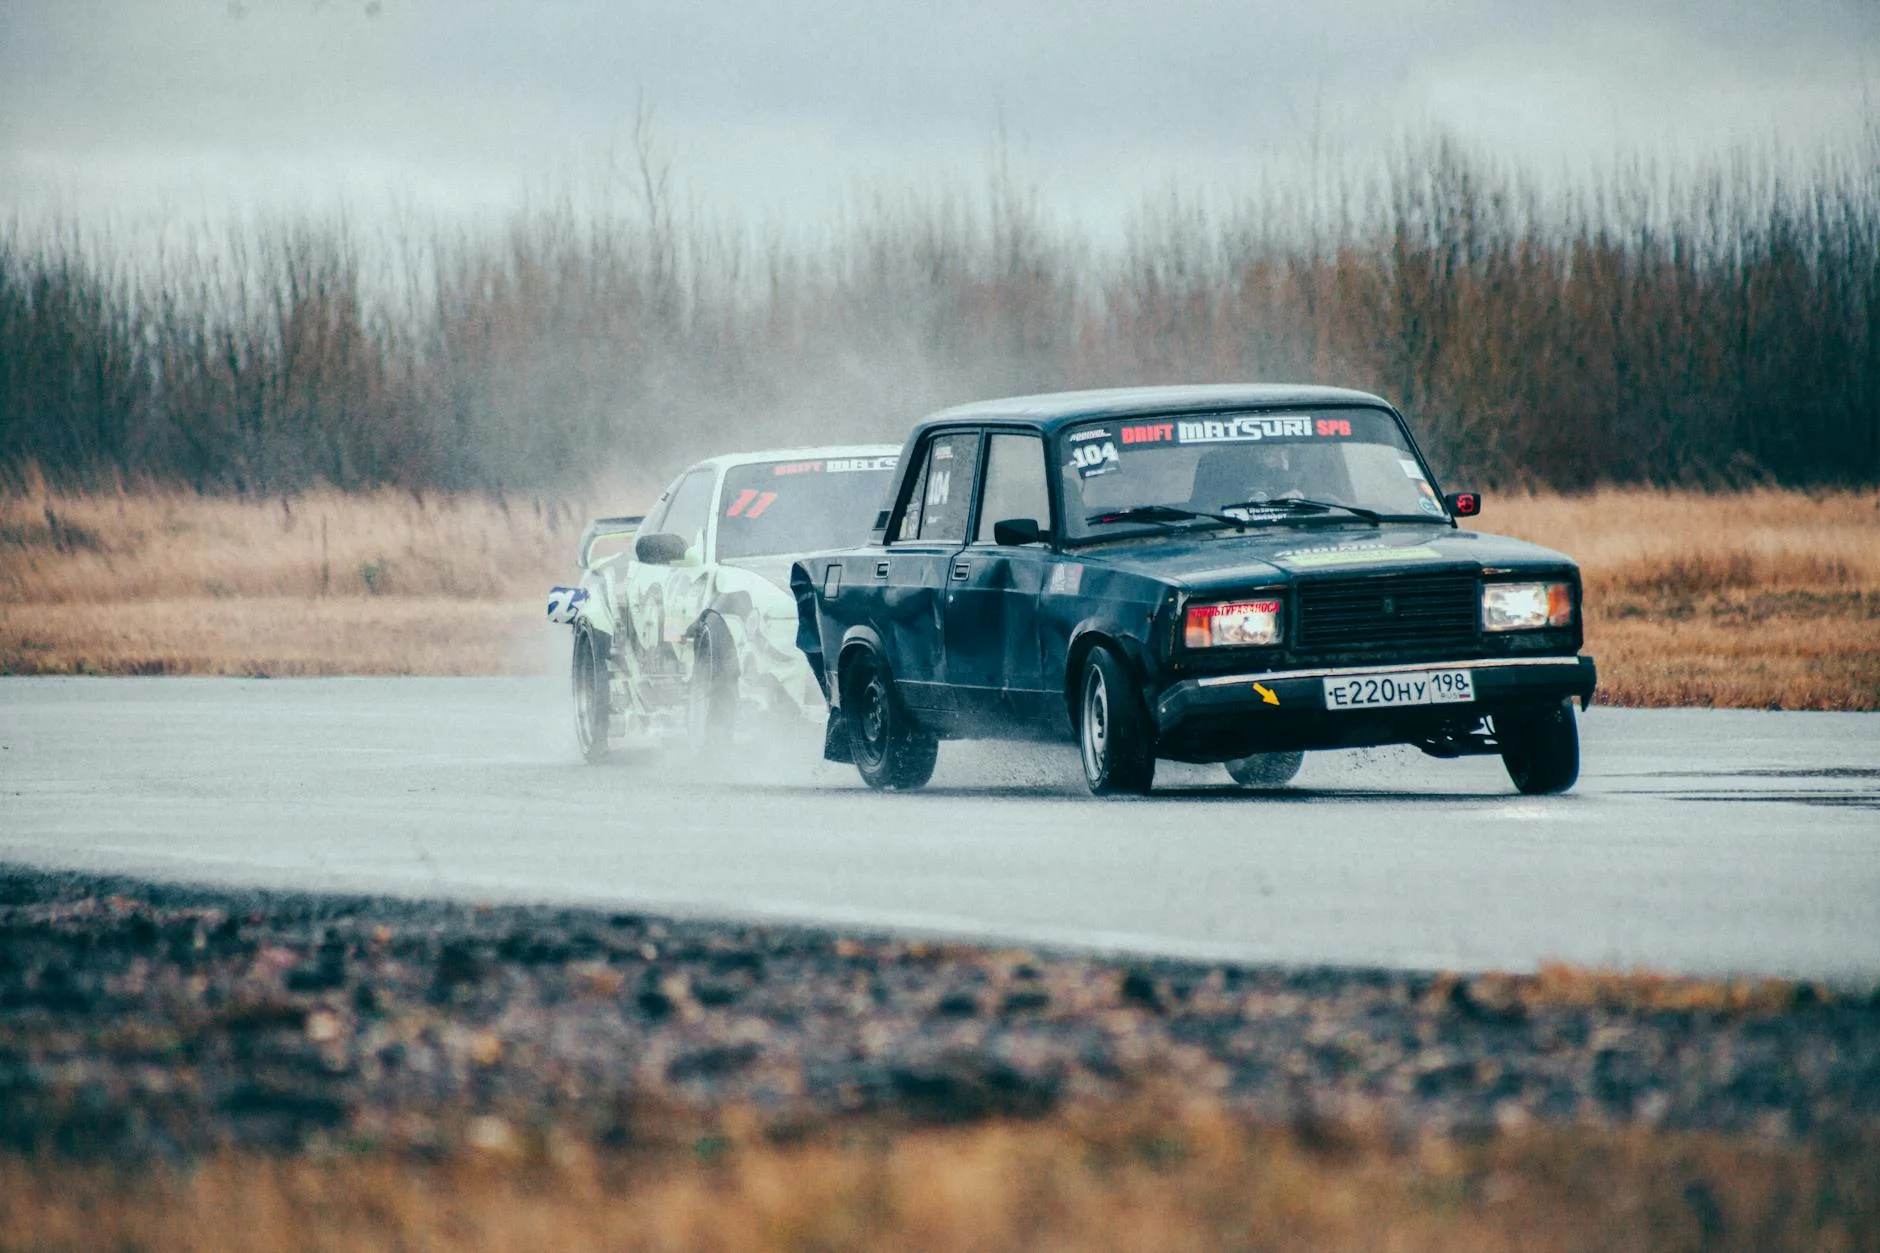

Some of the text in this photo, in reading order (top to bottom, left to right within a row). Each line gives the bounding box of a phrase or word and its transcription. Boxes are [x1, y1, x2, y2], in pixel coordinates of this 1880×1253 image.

[1121, 416, 1352, 444] DRIFT MATSURI SPB
[774, 461, 825, 476] DRIFT
[1069, 442, 1120, 469] 104
[928, 470, 951, 506] 104
[726, 488, 779, 519] 11
[1333, 678, 1427, 706] Е220НУ
[1432, 673, 1468, 692] 198
